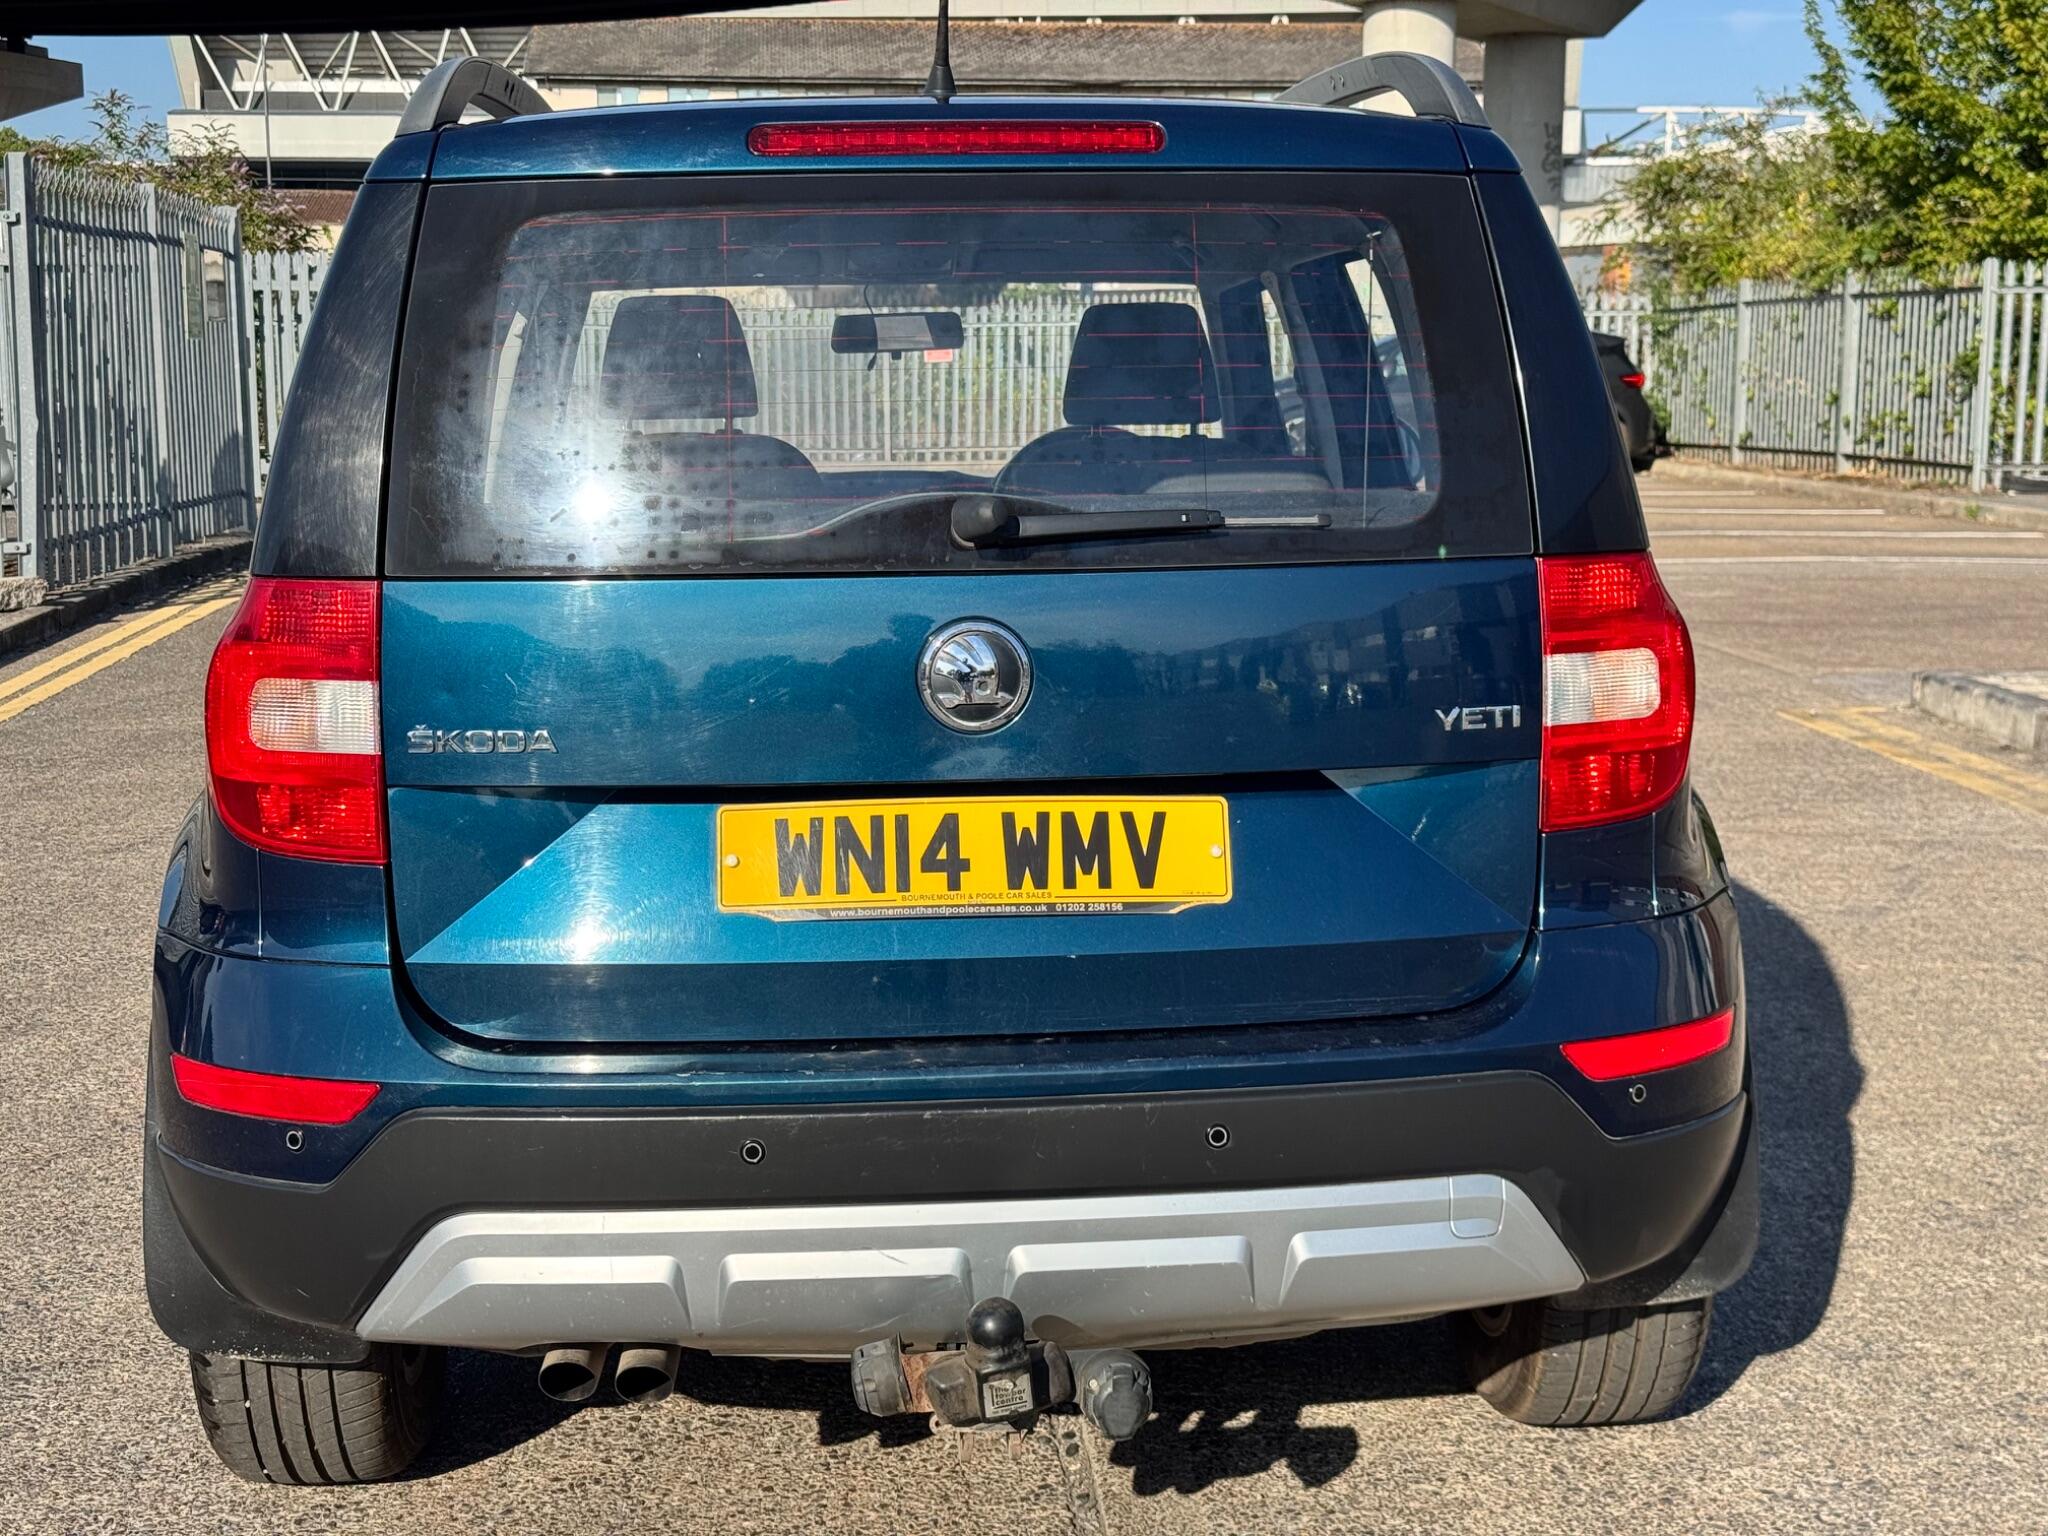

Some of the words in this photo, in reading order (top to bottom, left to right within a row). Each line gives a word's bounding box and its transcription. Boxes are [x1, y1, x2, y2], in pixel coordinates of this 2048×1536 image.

[1435, 705, 1521, 731] YETI
[407, 724, 559, 754] ŠKODA
[774, 813, 971, 897] WN14
[1002, 811, 1167, 890] WMV
[901, 893, 966, 902] BOURNEMOUTH
[976, 892, 1004, 900] POOLE
[1006, 891, 1023, 899] CAR
[1025, 891, 1053, 899] SALES
[829, 903, 1048, 917] www.bournemouthandpoolecarsales.co.uk
[1055, 903, 1085, 912] 01202
[1087, 902, 1124, 912] 258156
[995, 1395, 1024, 1405] centre
